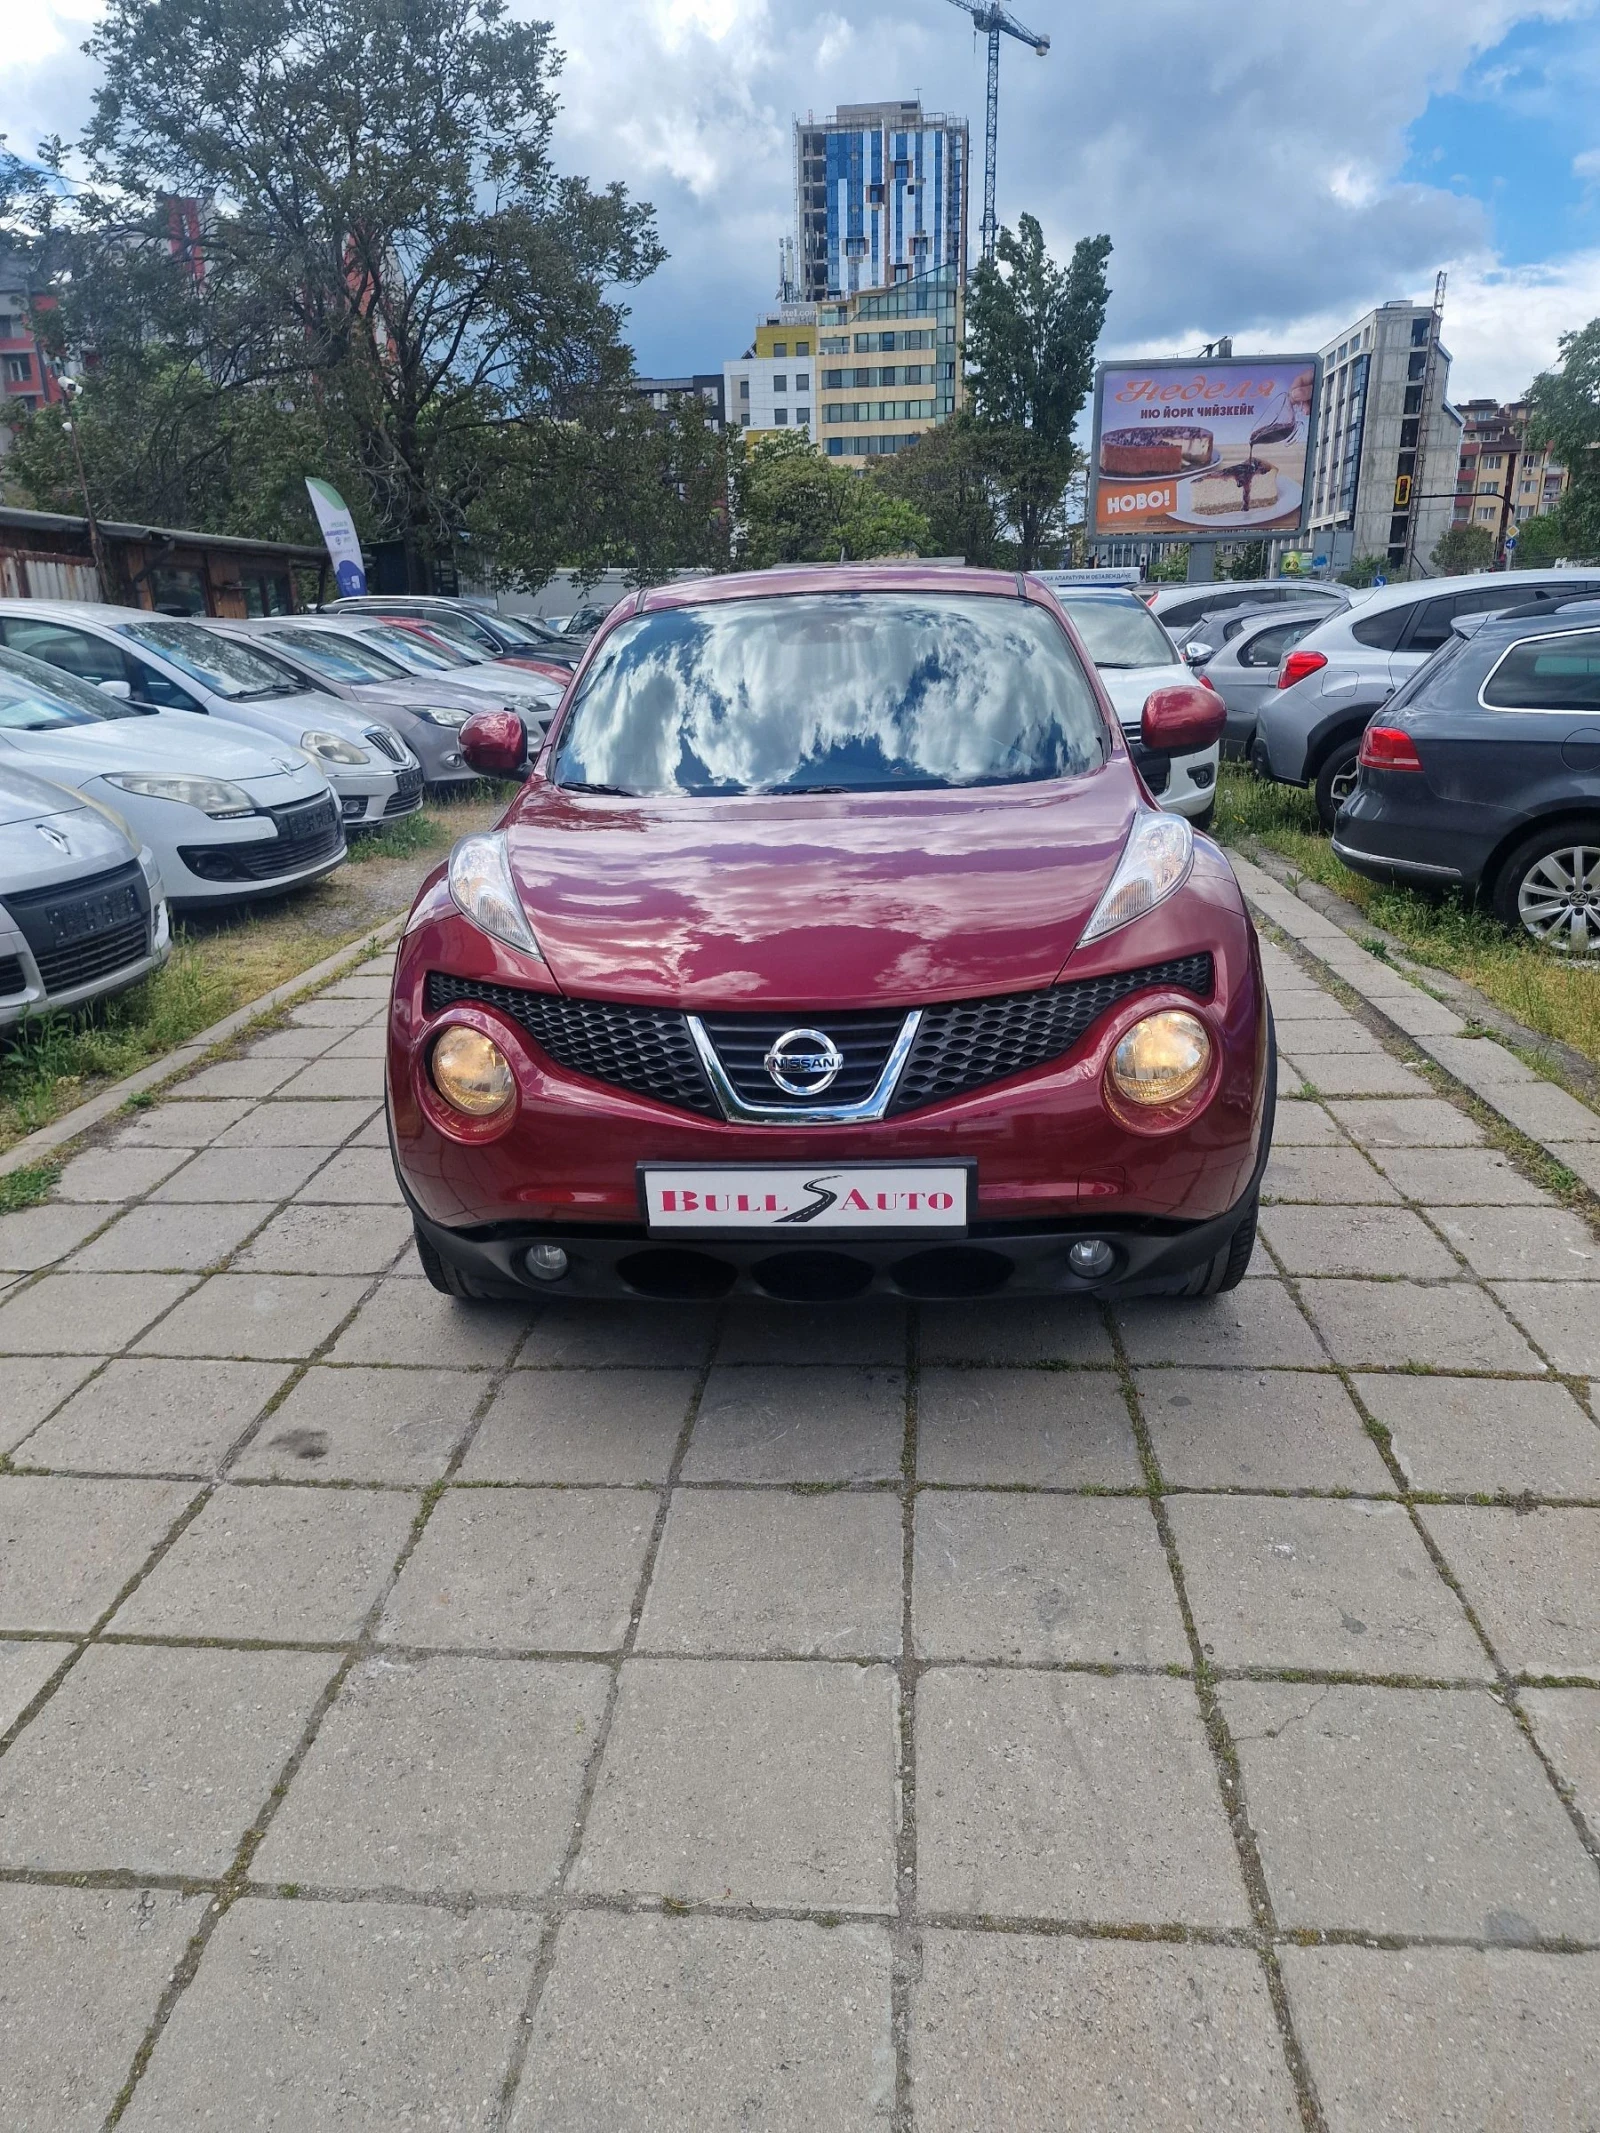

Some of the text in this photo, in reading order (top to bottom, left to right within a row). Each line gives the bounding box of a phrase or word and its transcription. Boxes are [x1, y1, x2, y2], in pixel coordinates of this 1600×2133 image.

[1115, 375, 1276, 404] Неделя
[1140, 403, 1255, 419] НЮ ЙОРК ЧИЙЗКЕЙК
[1107, 489, 1170, 515] НОВО!
[772, 1057, 835, 1070] NISSAN
